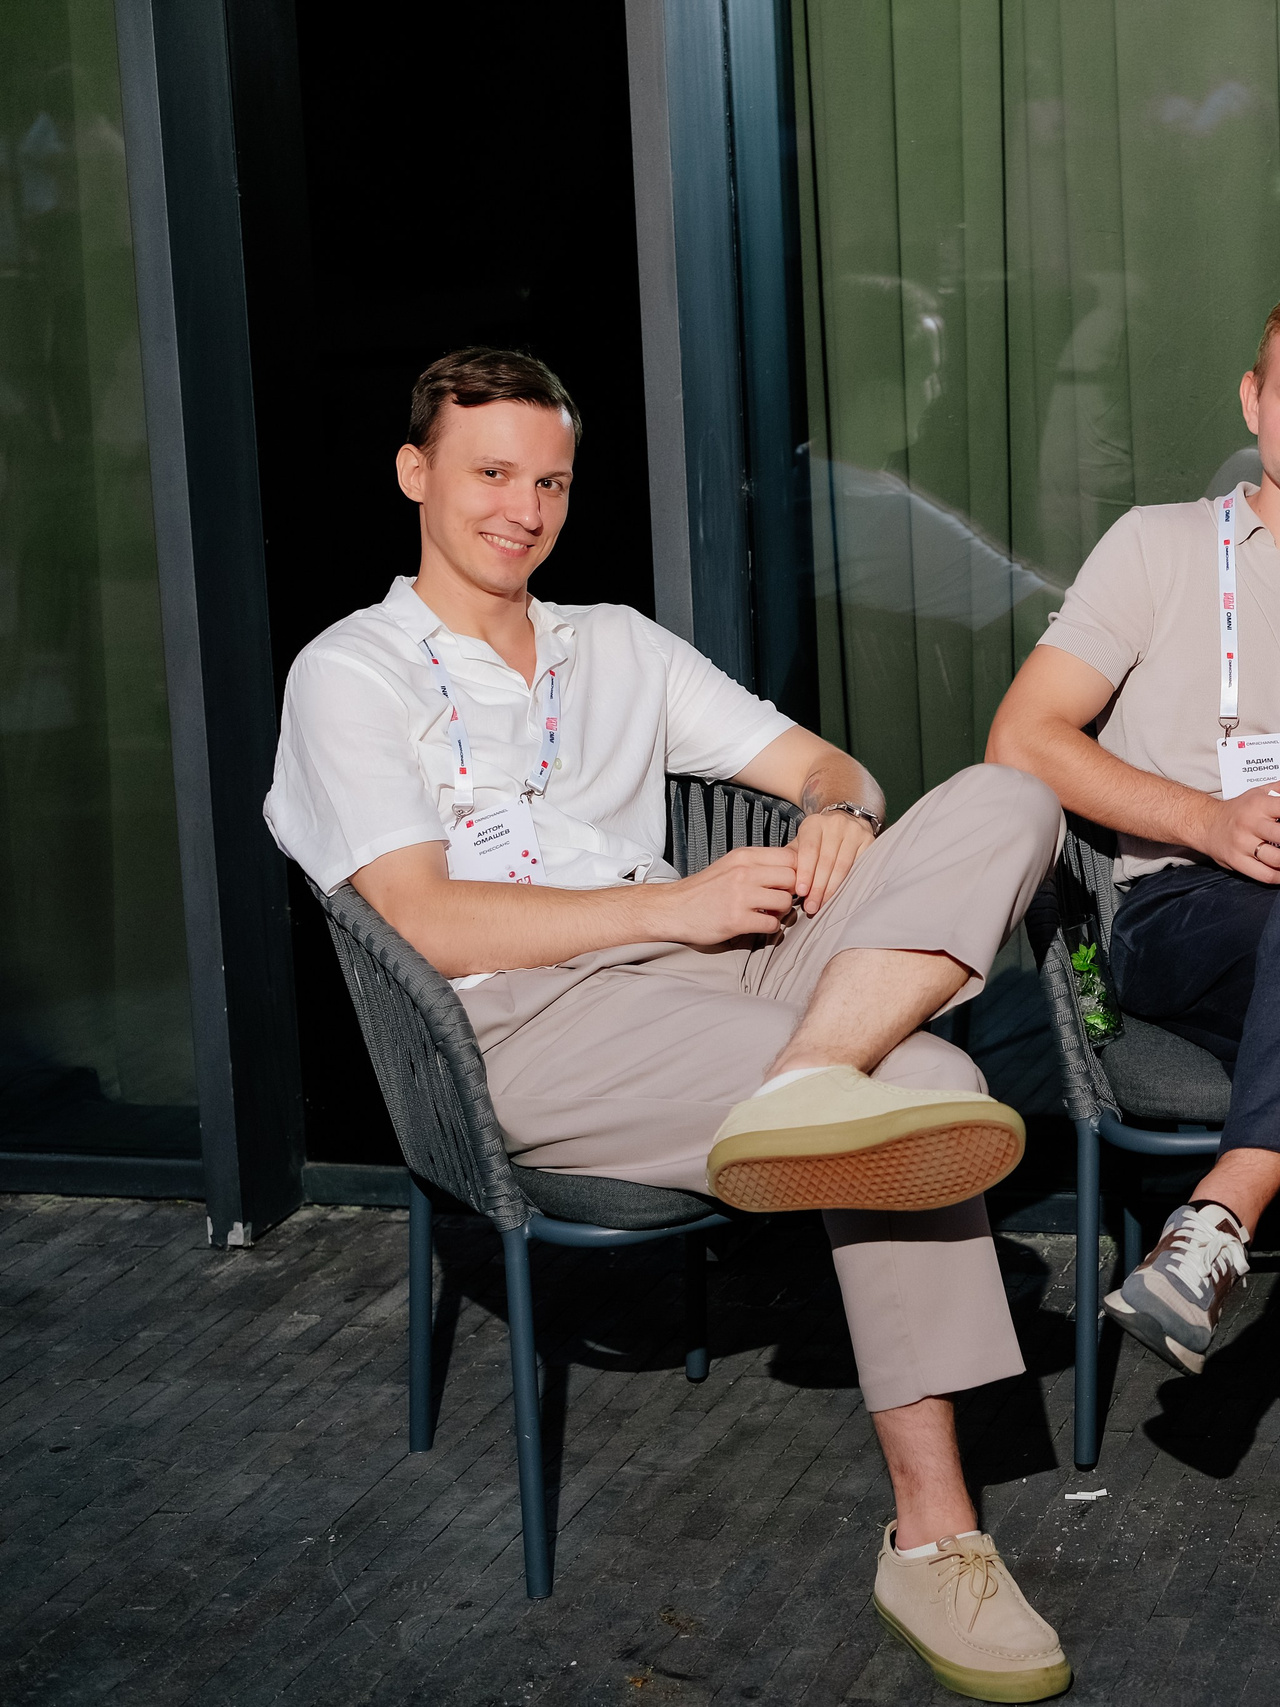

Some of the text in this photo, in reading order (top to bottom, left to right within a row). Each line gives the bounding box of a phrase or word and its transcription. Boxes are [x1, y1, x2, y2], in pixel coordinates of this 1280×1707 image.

[440, 685, 449, 699] MNI
[1245, 757, 1274, 765] ВАДИМ
[1242, 764, 1280, 773] ЗДОБНОВ
[473, 828, 511, 847] ЮМАШЕВ
[477, 823, 504, 838] АНТОН
